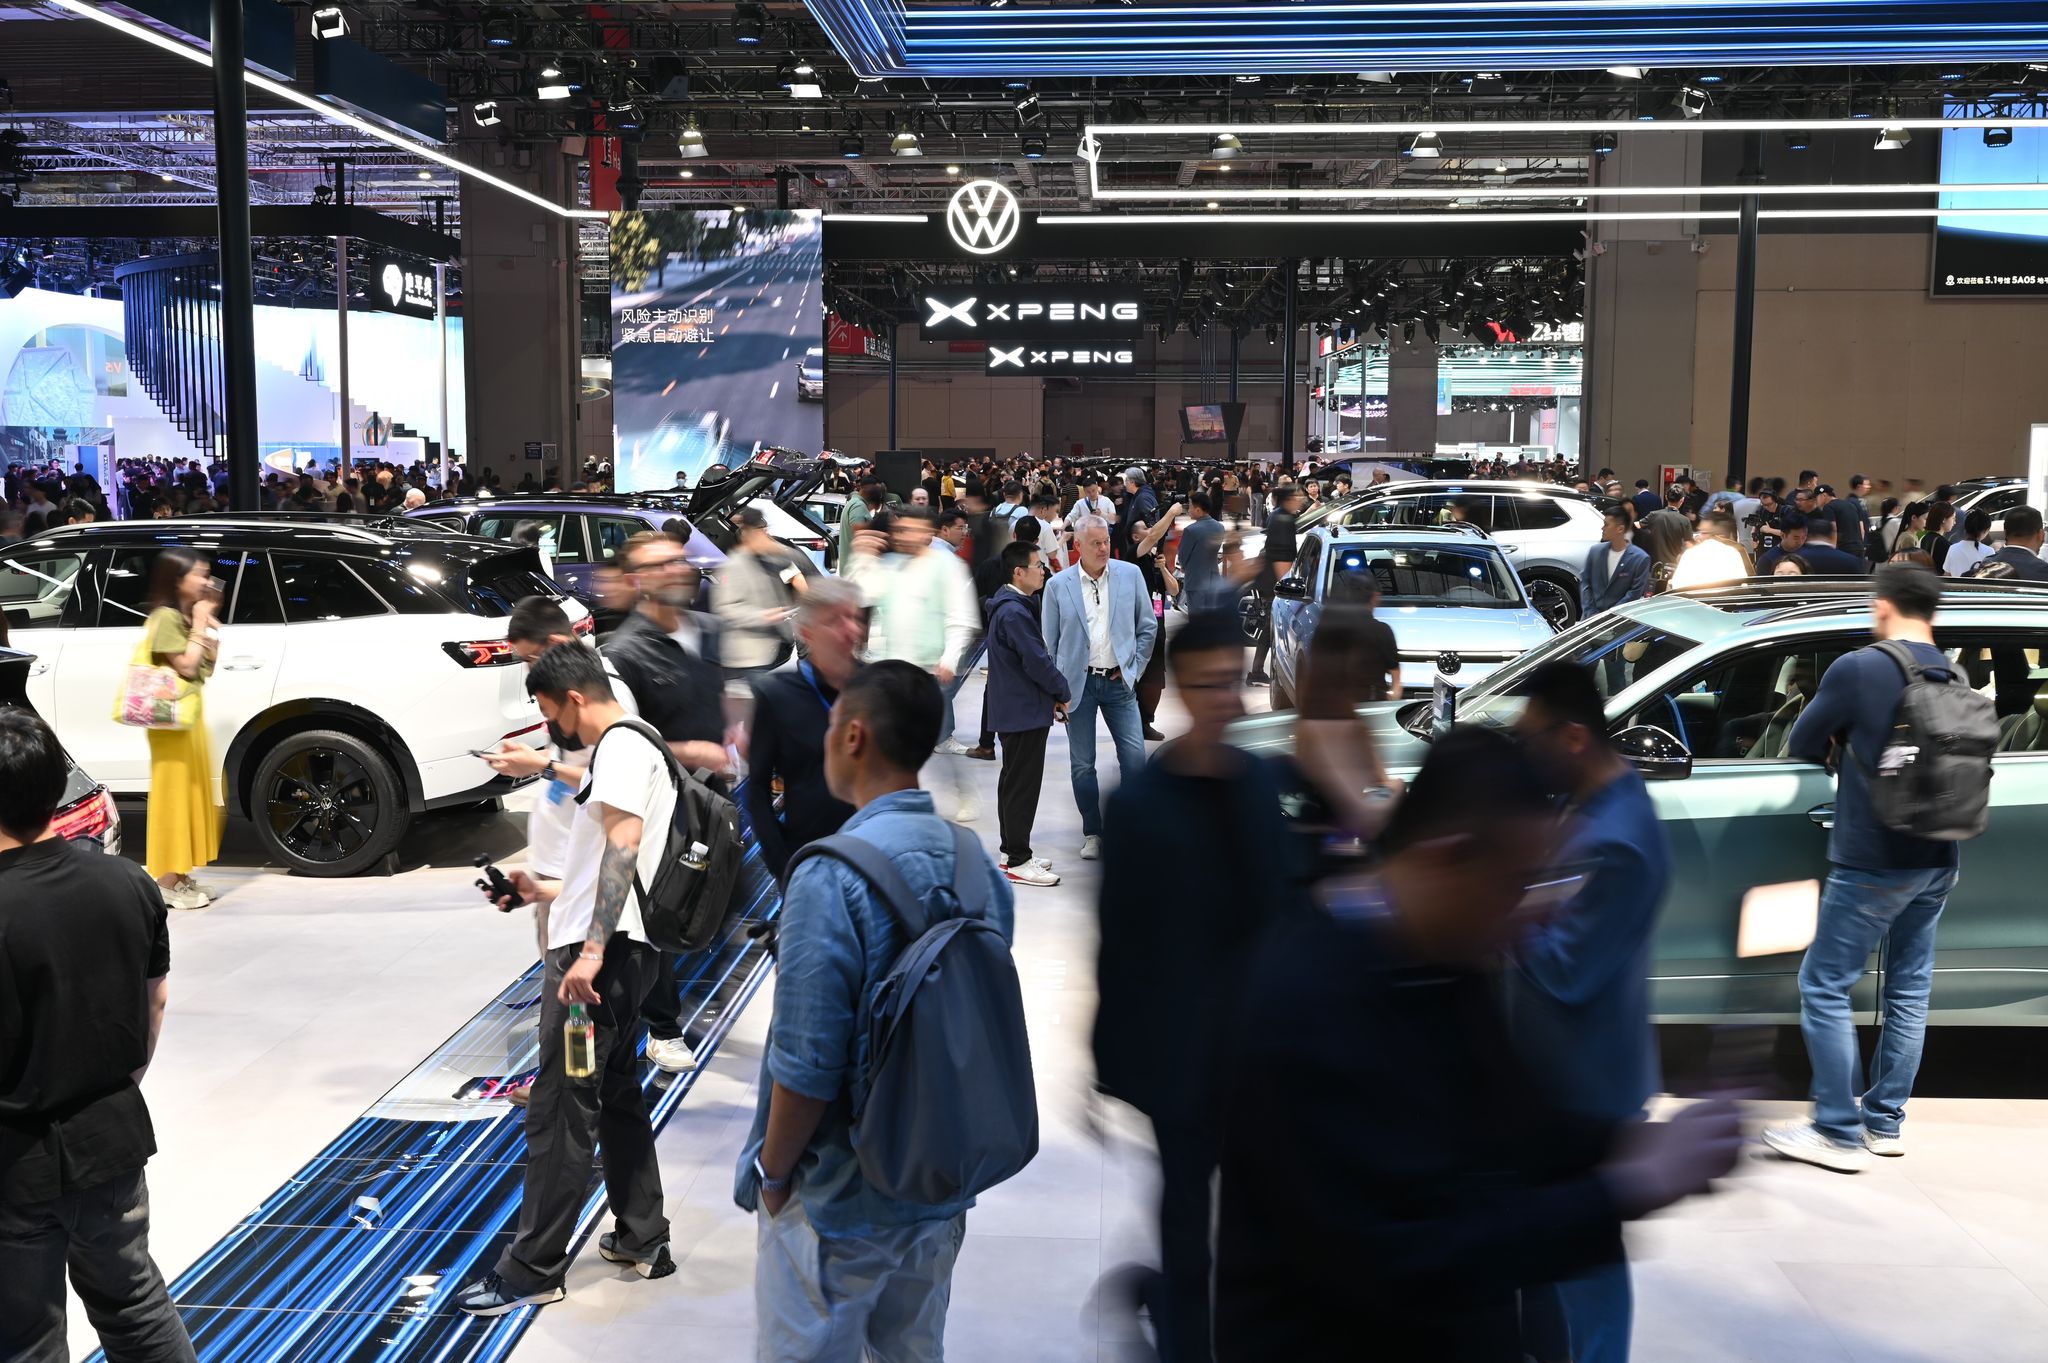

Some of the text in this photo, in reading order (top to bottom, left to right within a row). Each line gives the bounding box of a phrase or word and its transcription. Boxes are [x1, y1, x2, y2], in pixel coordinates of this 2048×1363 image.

[2012, 275, 2036, 285] 5A05
[620, 308, 713, 324] 风险主动识别
[986, 303, 1138, 320] XPENG
[620, 328, 715, 343] 紧急自动避让
[1030, 351, 1133, 363] XPENG
